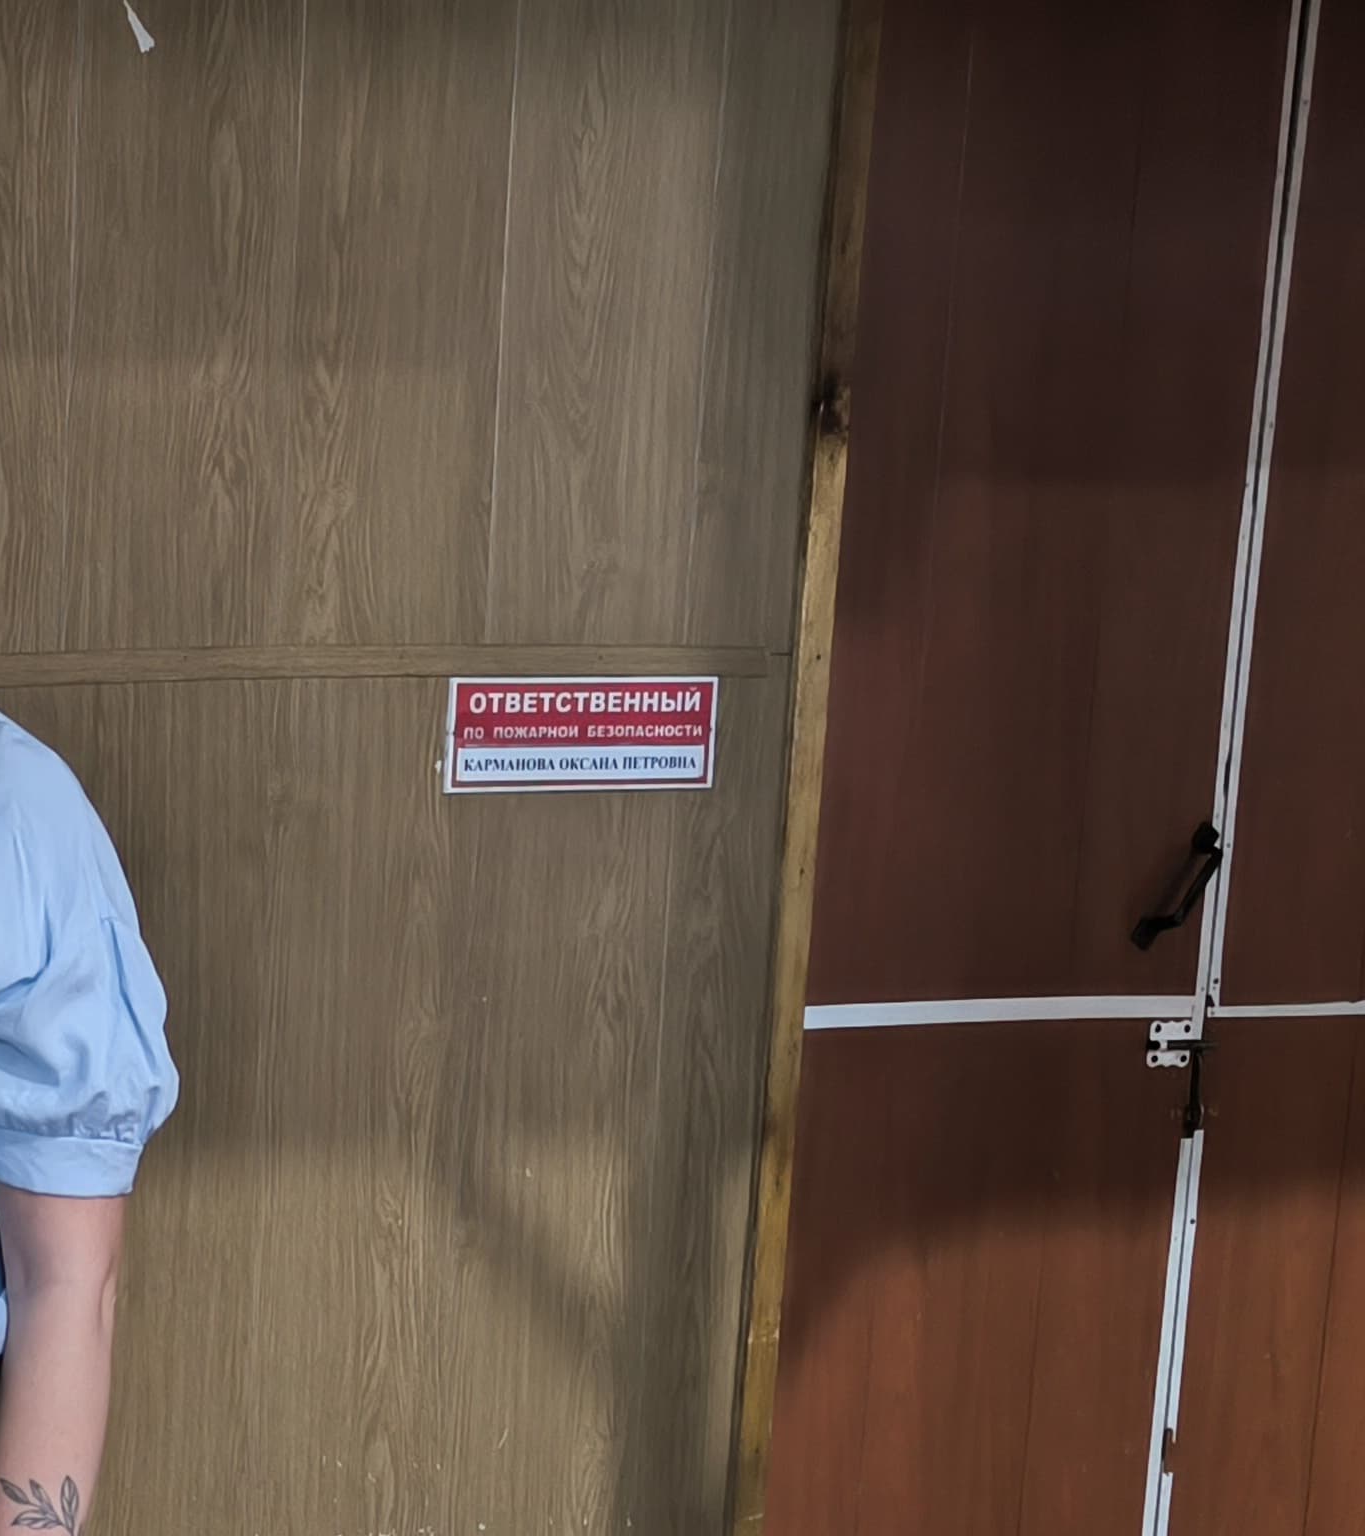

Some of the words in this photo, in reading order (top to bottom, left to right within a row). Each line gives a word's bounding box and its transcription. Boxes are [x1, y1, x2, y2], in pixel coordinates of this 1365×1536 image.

[469, 687, 701, 714] ОТВЕТСТВЕННЫЙ
[464, 726, 484, 740] ПО
[587, 724, 703, 739] БЕЗОПАСНОСТИ
[464, 757, 556, 773] КАРМАНОВА
[559, 756, 619, 771] ОКСАНА
[622, 755, 697, 771] ПЕТРОВНА
